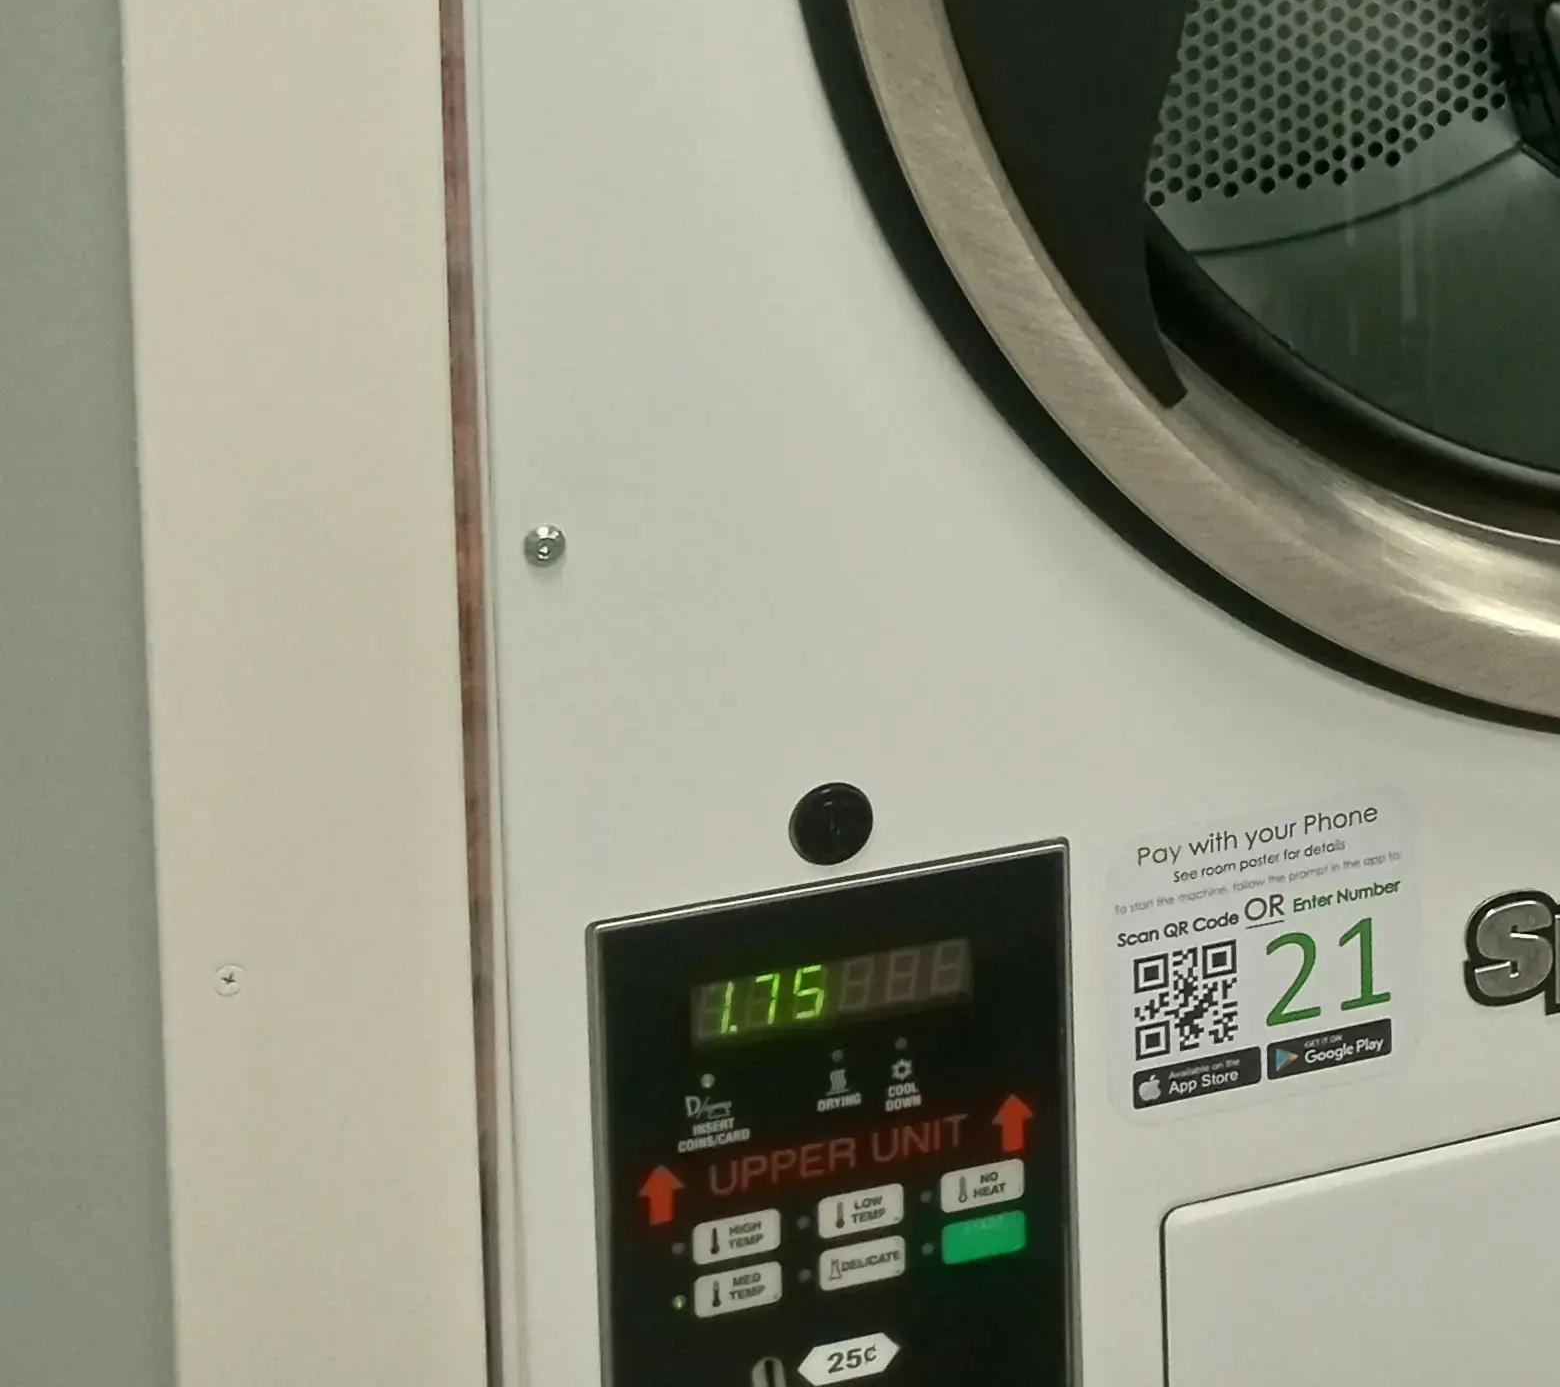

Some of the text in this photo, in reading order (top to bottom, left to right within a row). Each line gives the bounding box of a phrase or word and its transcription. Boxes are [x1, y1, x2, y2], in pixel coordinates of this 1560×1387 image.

[1137, 807, 1378, 866] Pay with your Phone
[1173, 839, 1346, 883] See room poster for details
[1117, 880, 1402, 948] Scan QR Code OR Enter Number
[1266, 917, 1391, 1027] 21
[719, 964, 828, 1034] 1.75
[1304, 1036, 1385, 1064] Google Play
[888, 1082, 919, 1098] COOL
[1169, 1070, 1239, 1095] App Store
[817, 1092, 862, 1112] DRYING
[885, 1094, 922, 1112] DOWN
[677, 1128, 751, 1153] COINS/CARD
[709, 1113, 970, 1197] UPPER UNIT
[979, 1171, 999, 1184] NO
[973, 1182, 1006, 1200] HEAT
[854, 1195, 883, 1211] LOW
[851, 1207, 886, 1224] TEMP
[728, 1233, 764, 1249] TEMP
[841, 1250, 901, 1272] DELICATE
[732, 1272, 761, 1287] MED
[729, 1285, 765, 1301] TEMP
